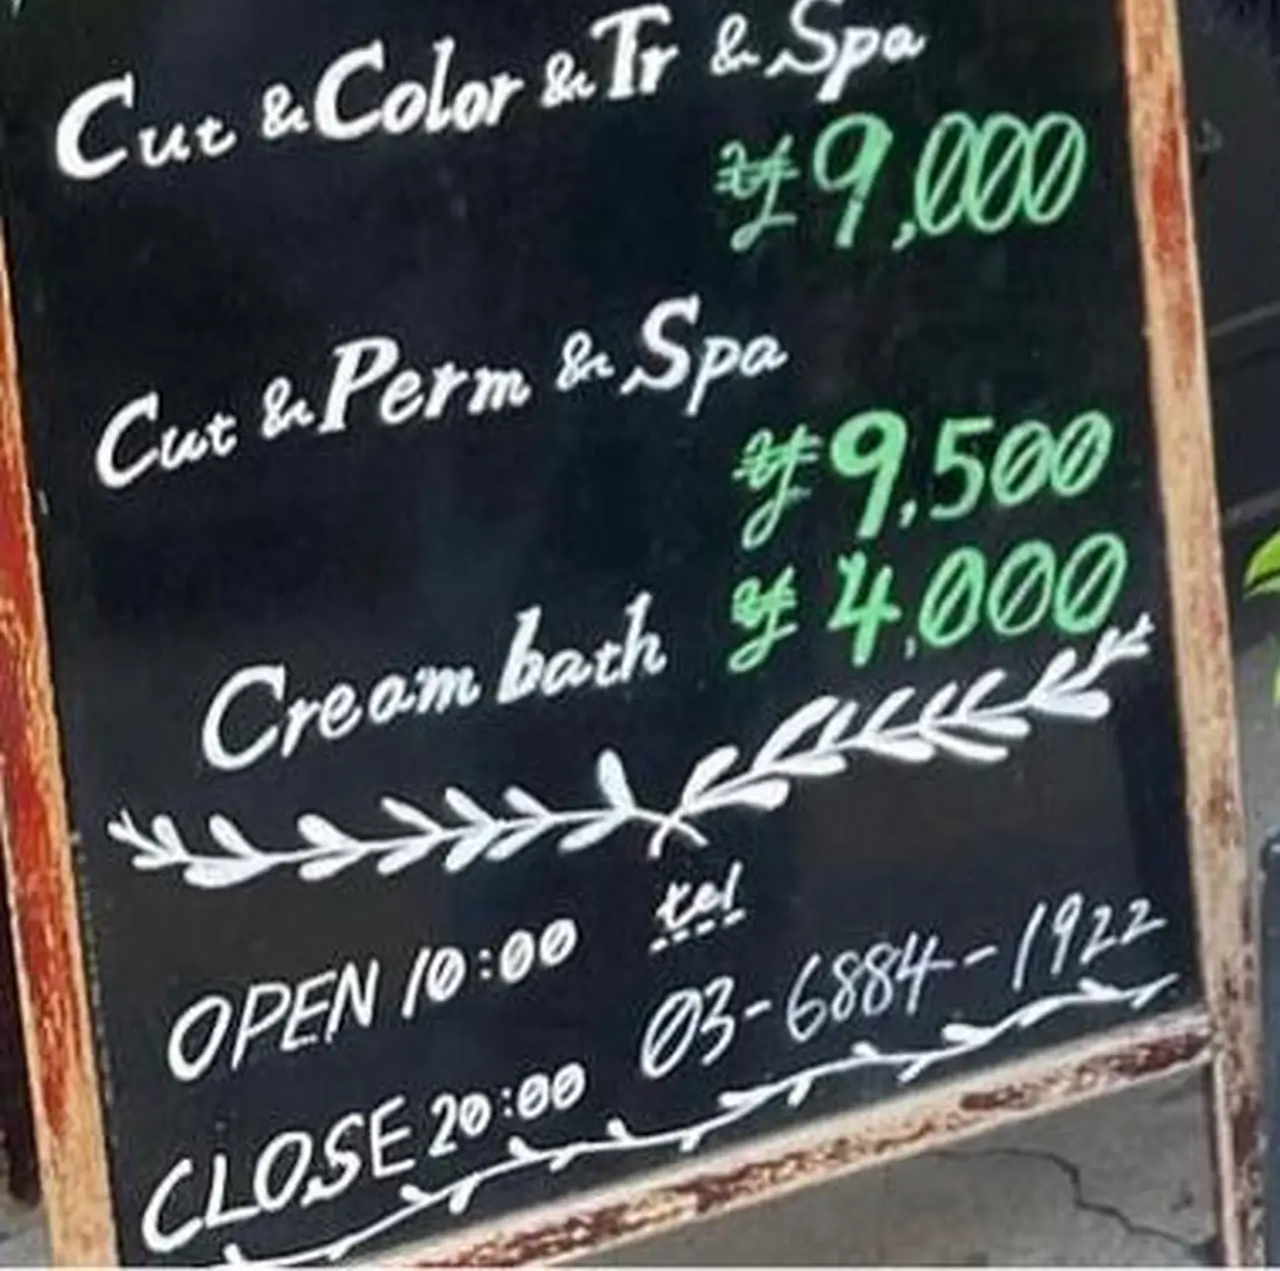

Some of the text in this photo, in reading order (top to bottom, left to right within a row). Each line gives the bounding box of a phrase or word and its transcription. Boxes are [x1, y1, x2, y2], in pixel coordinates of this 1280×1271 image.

[55, 72, 237, 179] Cut
[96, 392, 237, 488] Cut
[202, 591, 667, 770] Cream bath
[656, 862, 742, 928] tel
[167, 919, 577, 1081] OPEN 10:00
[640, 892, 1166, 1079] 03-6884-1922
[141, 1063, 586, 1253] CLOSE 20:00
